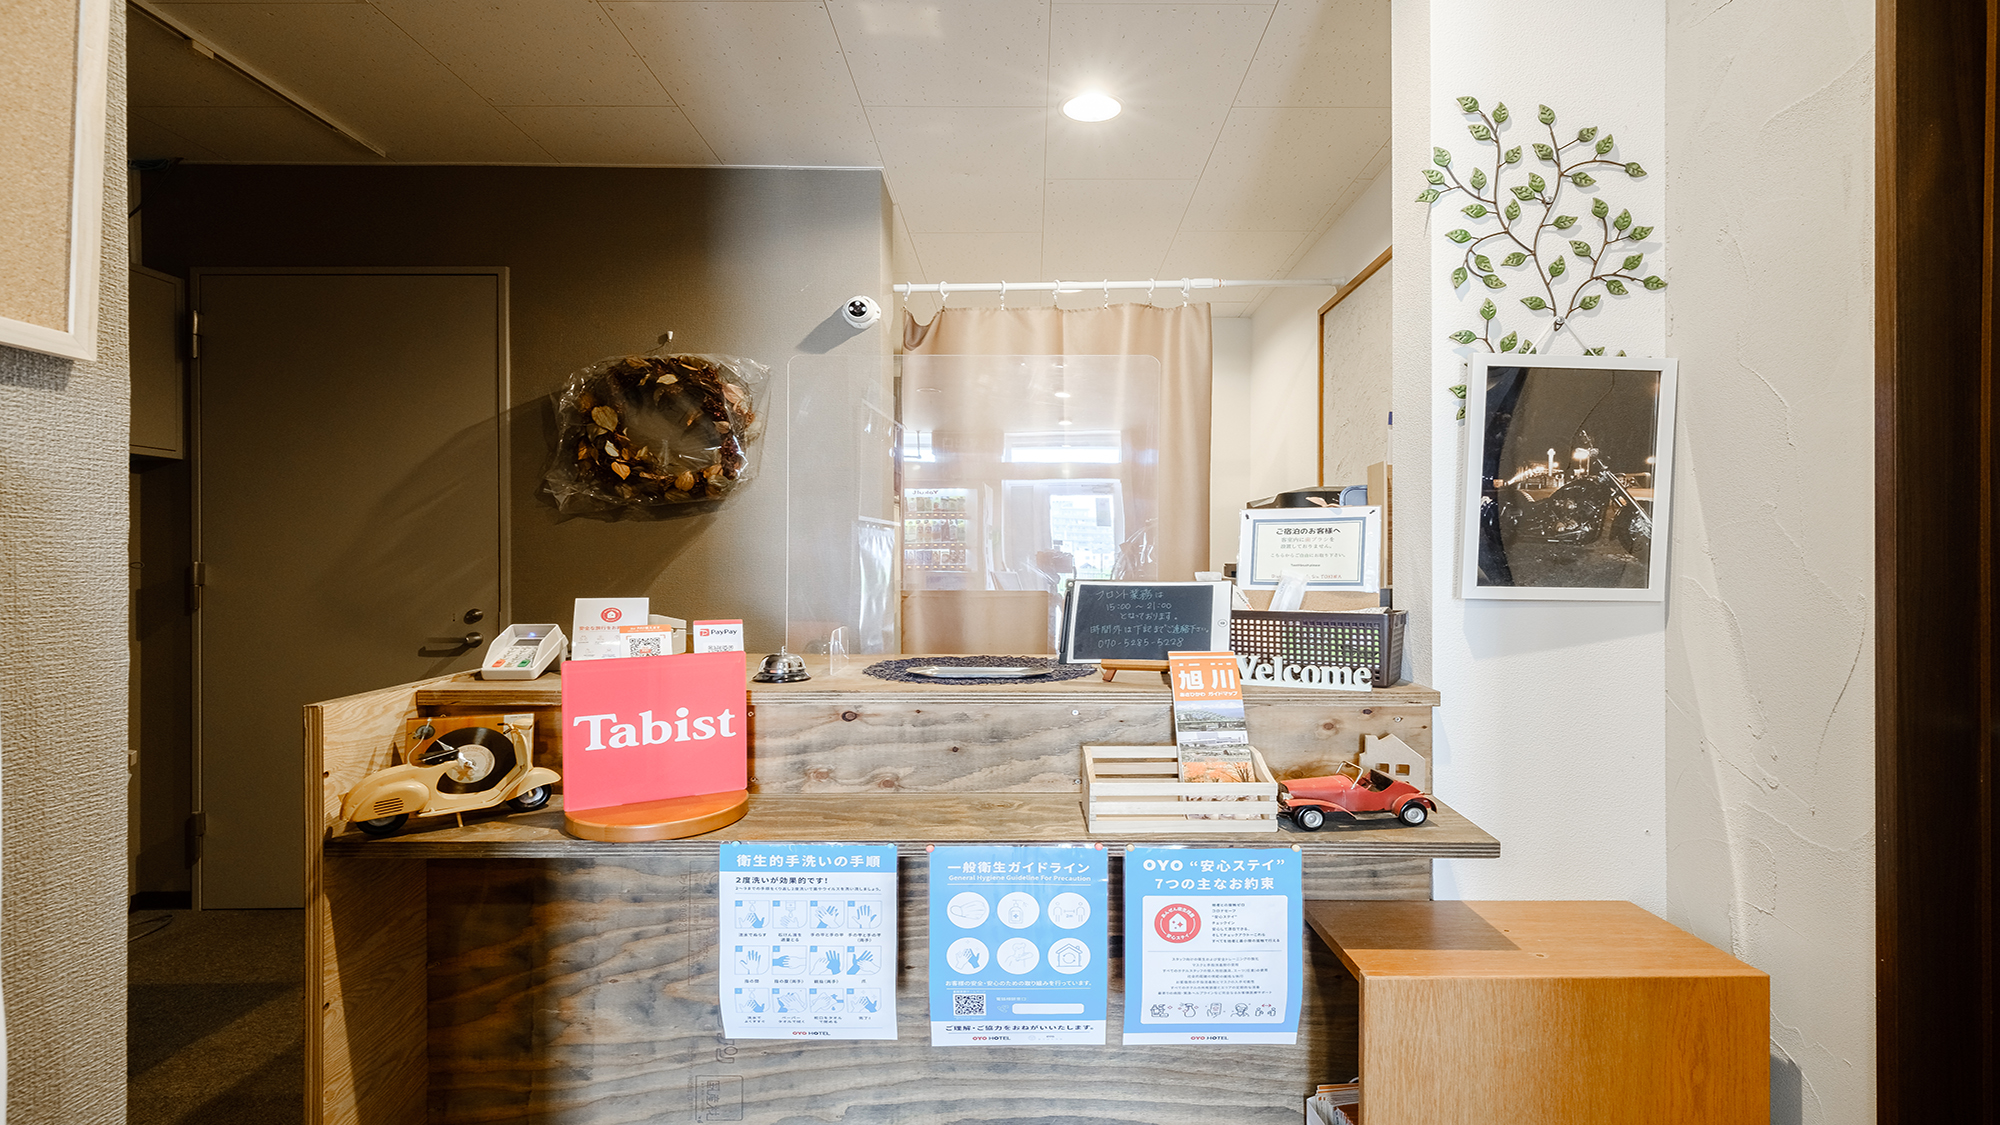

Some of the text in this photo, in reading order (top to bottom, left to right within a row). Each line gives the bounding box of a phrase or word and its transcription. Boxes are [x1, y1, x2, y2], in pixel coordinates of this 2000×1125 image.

[1096, 589, 1164, 600] フロント業務は
[1107, 603, 1131, 611] 15:00
[1147, 602, 1172, 610] 21:00
[1098, 637, 1184, 648] 070-5285-5228
[1179, 669, 1235, 690] 旭川
[573, 707, 736, 751] Tabist
[737, 854, 881, 868] 衛生的手洗いの手順
[1143, 860, 1184, 871] OYO
[947, 862, 1090, 874] 一般衛生ガイドライン
[1155, 878, 1274, 890] 7つの主なお約束
